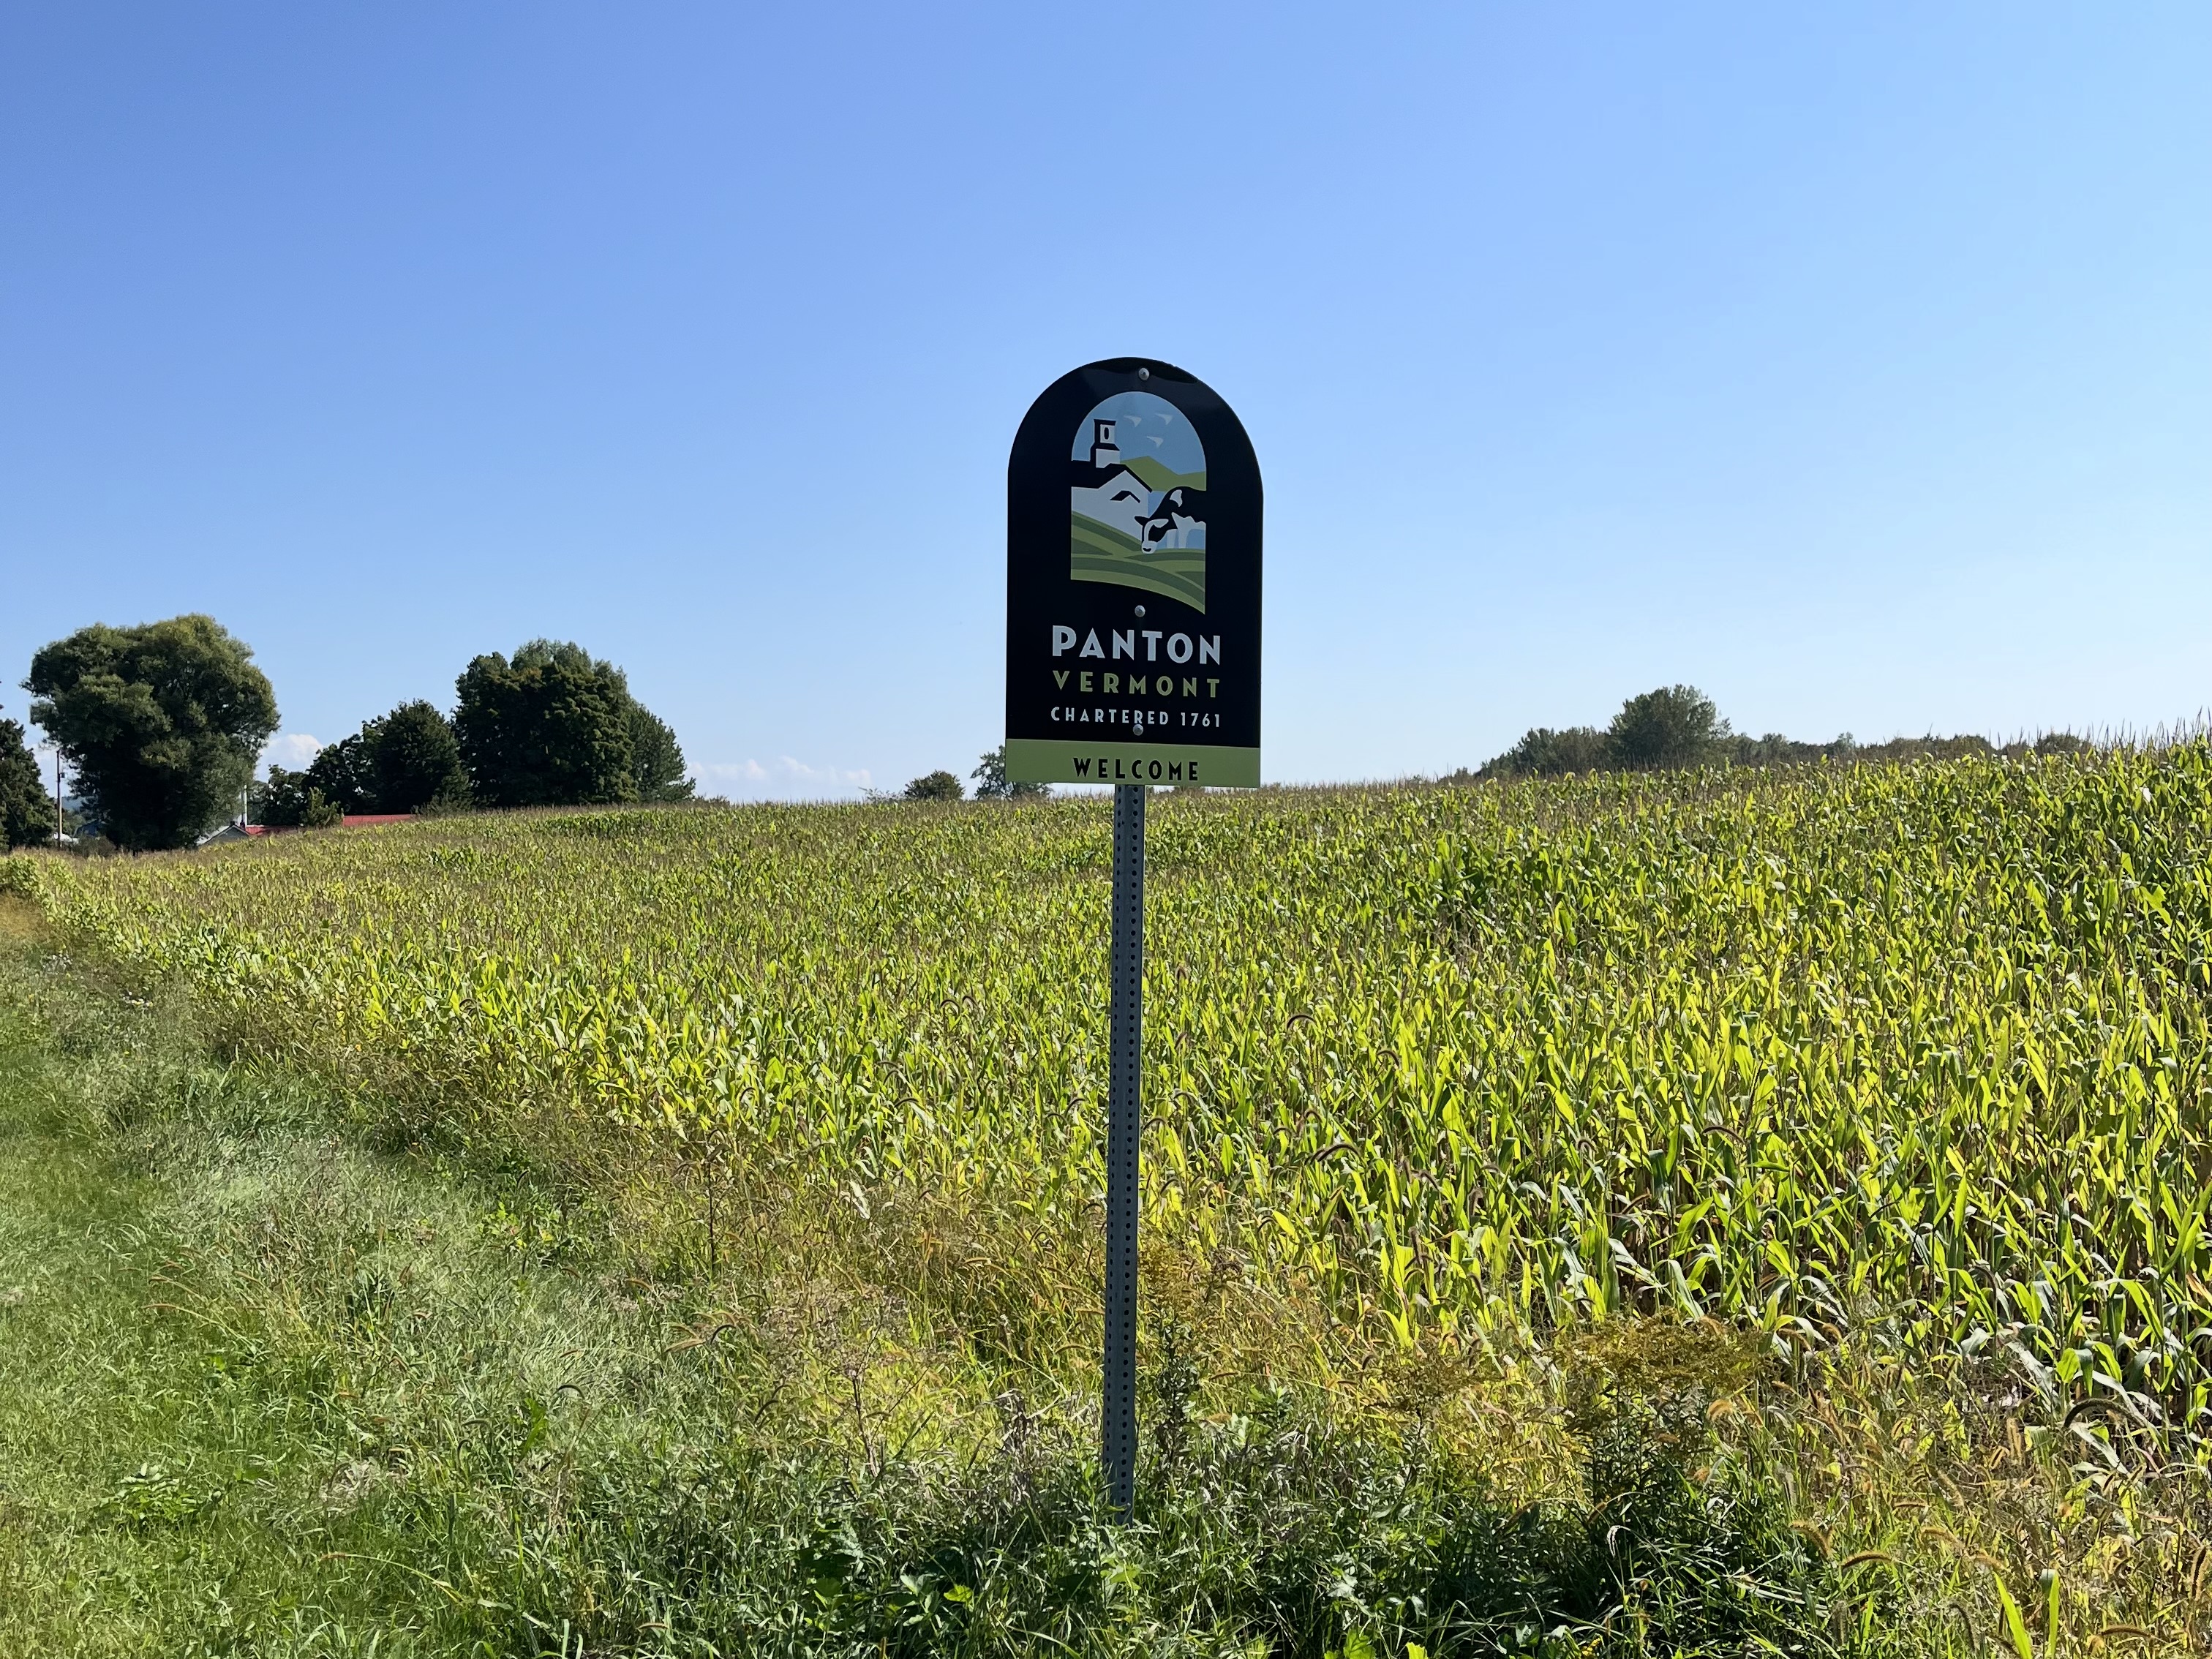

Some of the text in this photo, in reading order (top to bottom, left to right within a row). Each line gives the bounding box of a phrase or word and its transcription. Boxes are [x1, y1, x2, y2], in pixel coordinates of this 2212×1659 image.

[1052, 625, 1221, 666] PANTON
[1052, 670, 1220, 699] VERMONT
[1050, 707, 1220, 728] CHARTERED 1761
[1072, 757, 1199, 781] WELCOME
